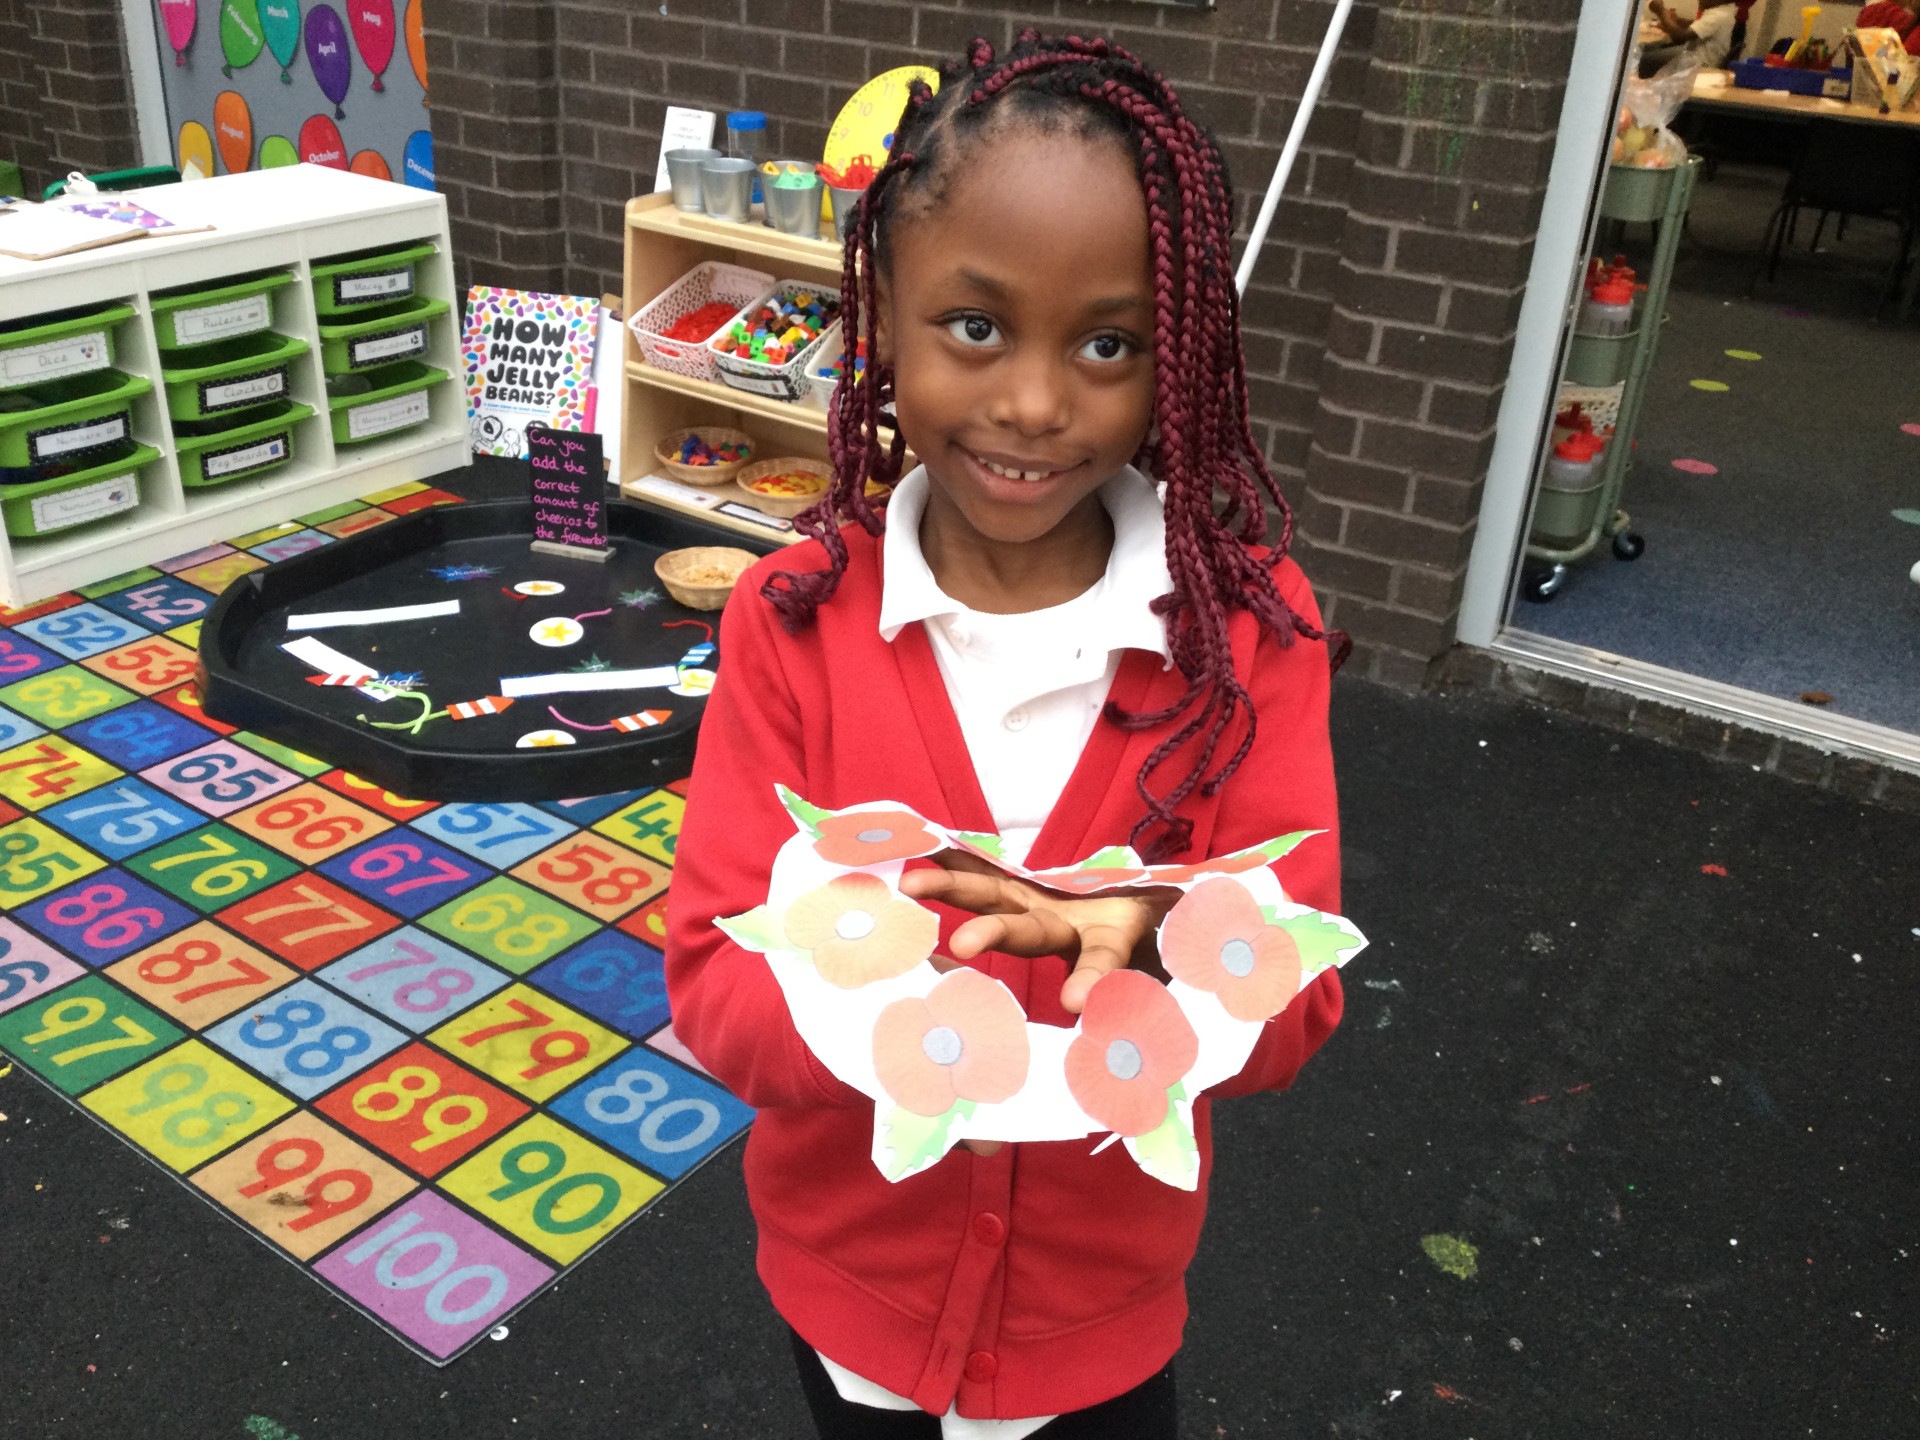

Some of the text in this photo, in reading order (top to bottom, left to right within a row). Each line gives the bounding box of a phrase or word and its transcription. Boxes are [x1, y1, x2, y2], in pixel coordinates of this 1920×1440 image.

[267, 5, 289, 19] March
[362, 11, 381, 27] May
[318, 41, 337, 57] April
[858, 101, 873, 117] 10
[884, 82, 896, 98] 11
[221, 122, 245, 139] August
[840, 127, 849, 141] 9
[308, 149, 340, 164] October
[407, 158, 435, 181] Decem
[203, 314, 243, 330] Rulers
[493, 316, 567, 347] HOW
[38, 353, 68, 368] Dice
[486, 362, 560, 390] JELLY
[489, 342, 563, 368] MANY
[223, 382, 264, 399] Clocks
[485, 385, 556, 408] BEANS?
[530, 428, 586, 457] Can you
[531, 455, 588, 474] add the
[533, 494, 600, 518] amount of
[535, 508, 598, 530] cheerios to
[536, 524, 556, 539] the
[126, 584, 208, 626] 42
[37, 611, 127, 652] 52
[104, 643, 198, 686] 53
[17, 675, 112, 718] 63
[88, 711, 177, 760] 64
[0, 743, 81, 798] 74
[168, 752, 279, 801] 65
[64, 787, 184, 845] 75
[256, 797, 364, 850] 66
[438, 802, 554, 849] 57
[0, 833, 81, 893] 85
[150, 833, 268, 896] 76
[349, 844, 470, 896] 67
[537, 844, 653, 906] 58
[44, 884, 164, 949] 86
[242, 884, 373, 946] 77
[452, 893, 570, 957] 68
[0, 936, 50, 1002] 6
[137, 940, 272, 1004] 87
[345, 939, 475, 1013] 78
[562, 949, 668, 1017] 69
[22, 996, 157, 1067] 97
[239, 1000, 371, 1078] 88
[458, 998, 590, 1081] 79
[126, 1063, 257, 1147] 98
[352, 1065, 488, 1153] 89
[584, 1069, 720, 1154] 80
[238, 1137, 373, 1232] 99
[489, 1140, 621, 1235] 90
[344, 1210, 508, 1326] 100
